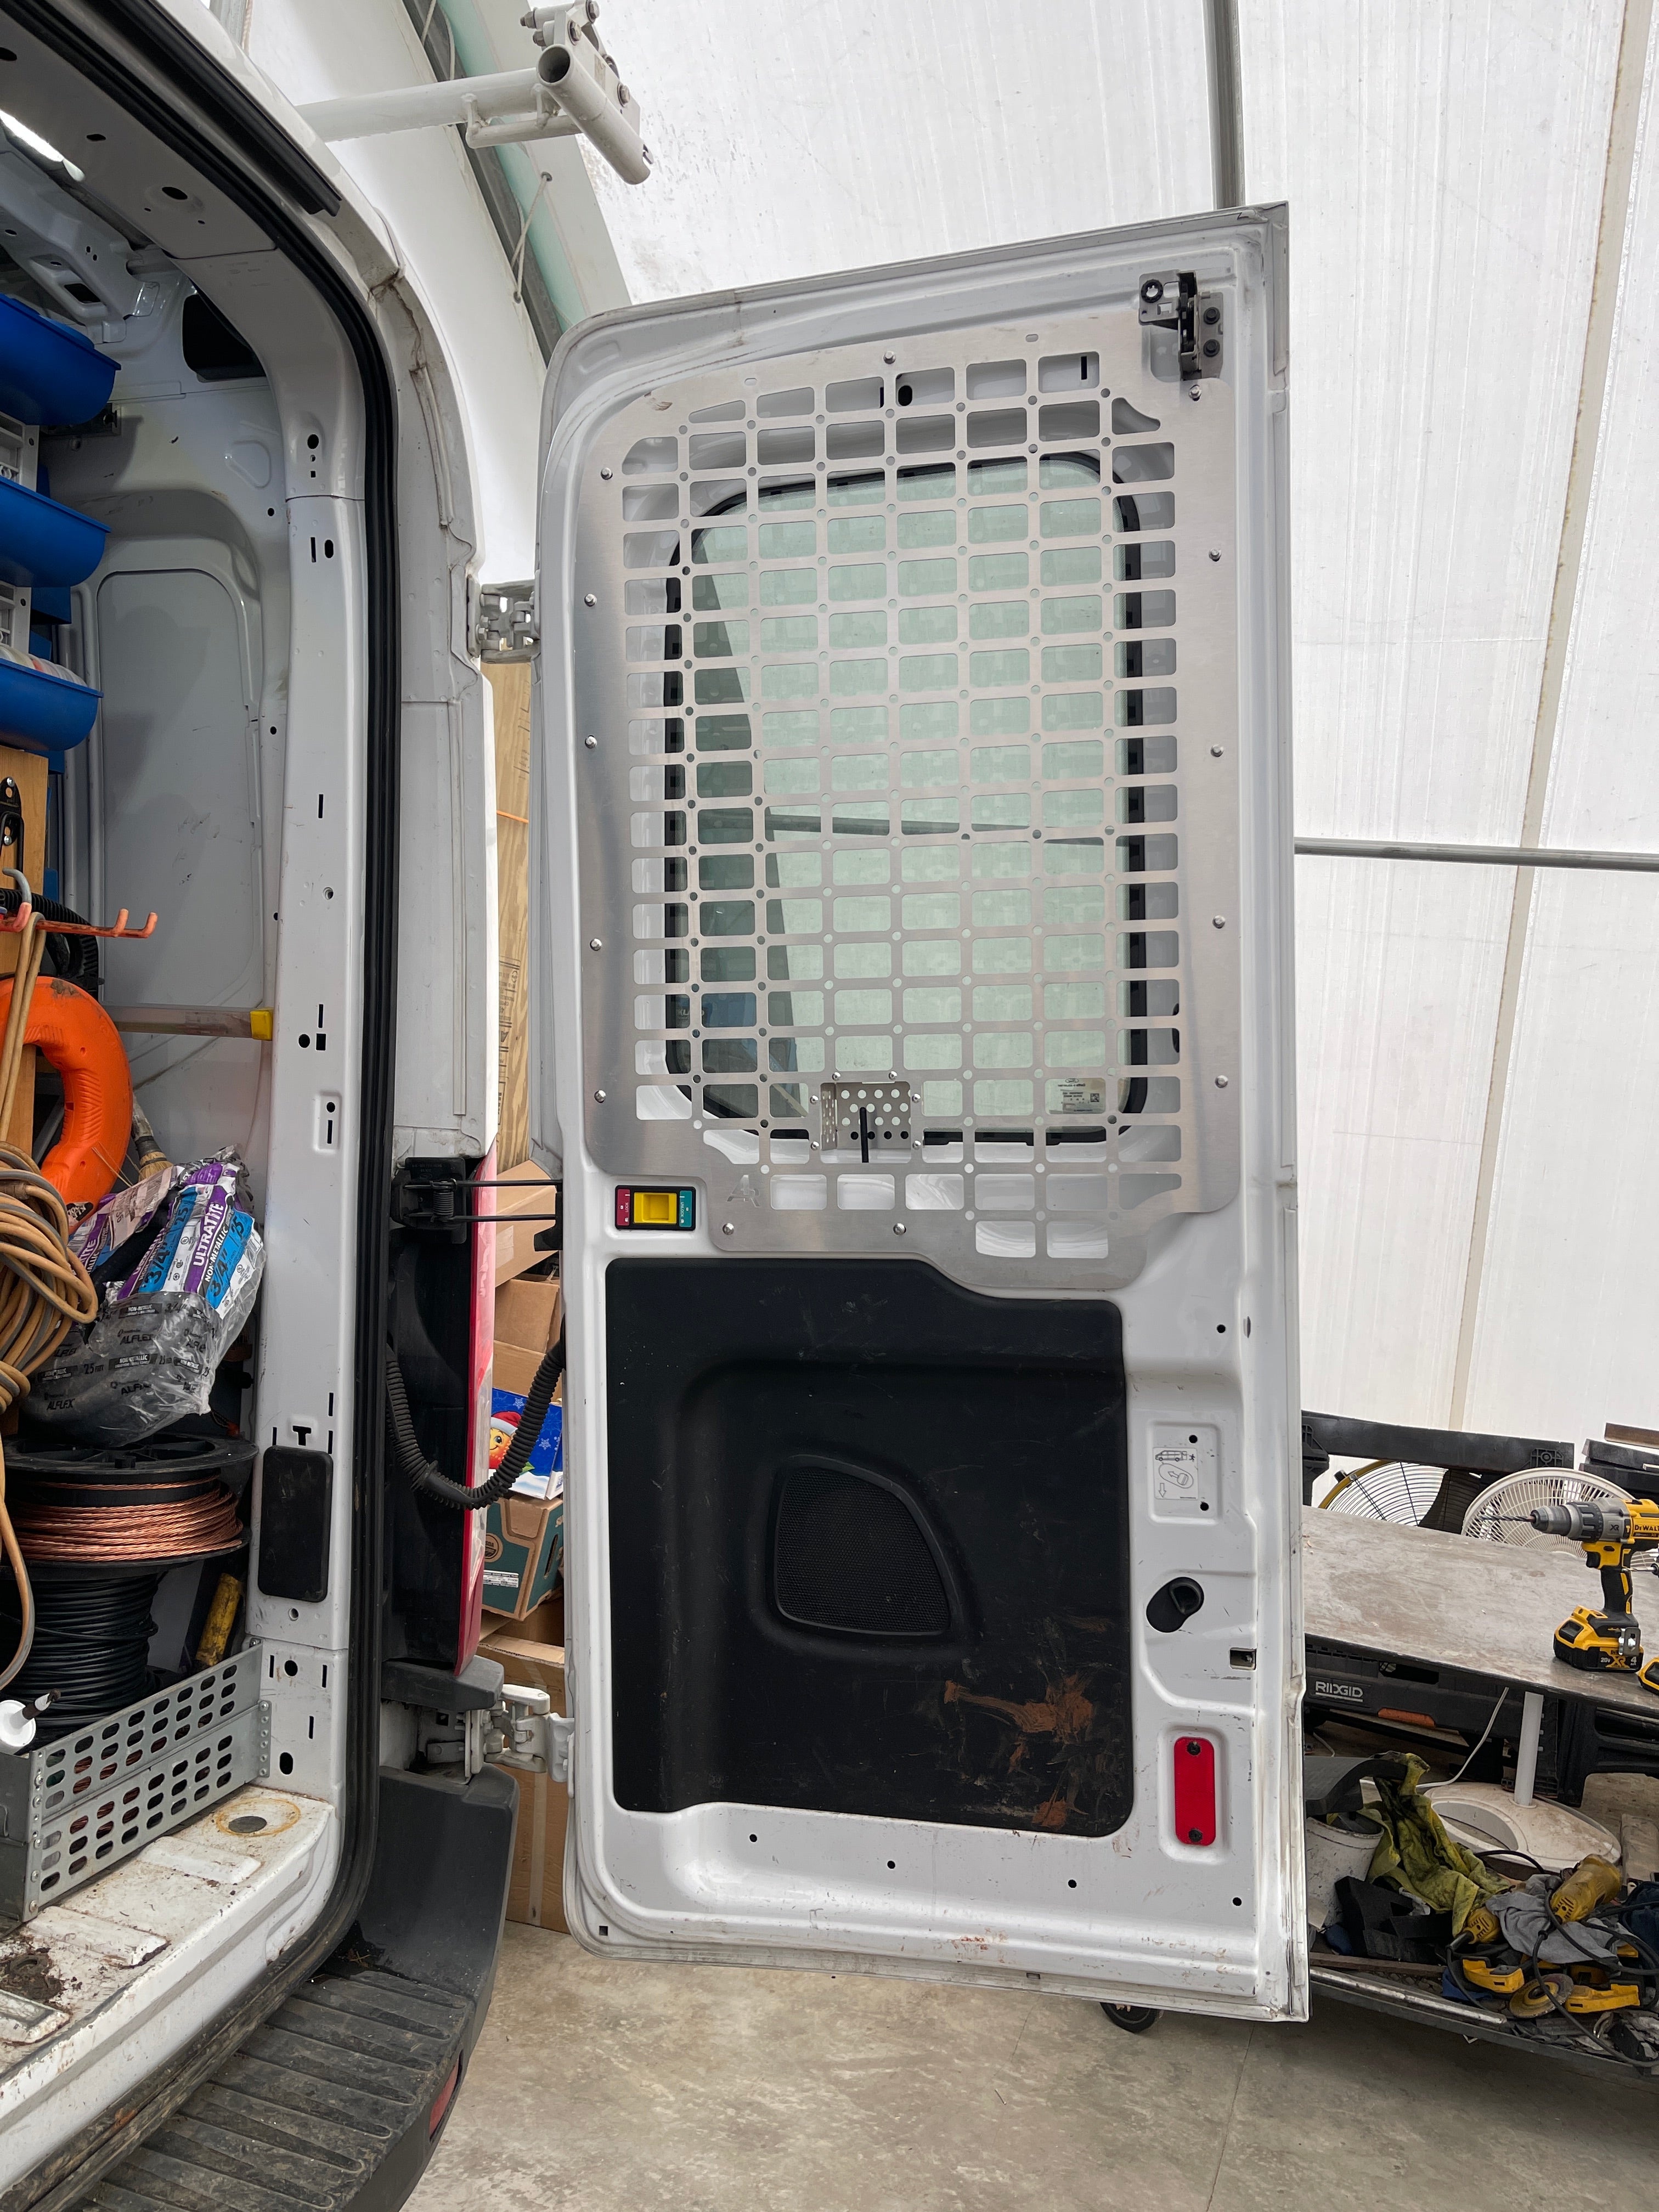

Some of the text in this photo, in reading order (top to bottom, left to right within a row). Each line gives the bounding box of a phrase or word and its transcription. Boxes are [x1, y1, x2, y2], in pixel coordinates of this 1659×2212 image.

[193, 1203, 224, 1266] ULTRATITE
[205, 1226, 229, 1282] NON-METALLIC
[120, 1334, 153, 1345] ALFLEX
[83, 1363, 94, 1374] 25
[1315, 1681, 1364, 1698] RIDGID
